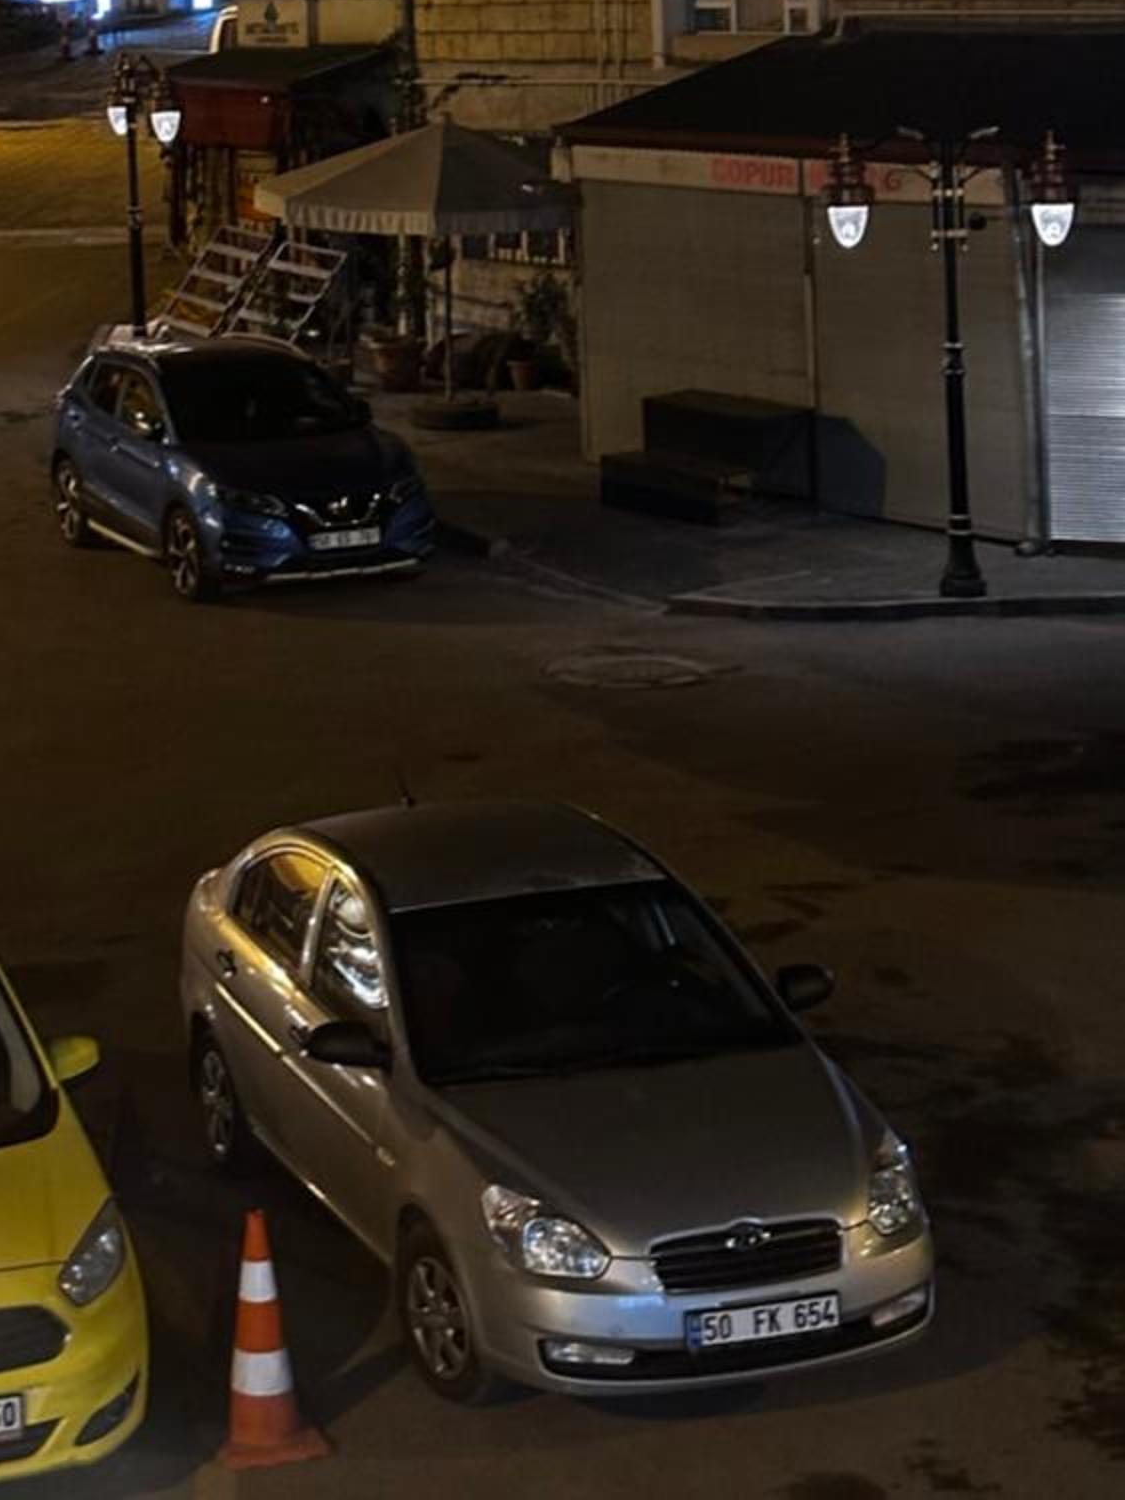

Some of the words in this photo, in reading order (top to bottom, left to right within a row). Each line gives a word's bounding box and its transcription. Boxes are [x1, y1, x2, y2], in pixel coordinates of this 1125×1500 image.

[703, 1314, 732, 1342] 50
[753, 1307, 781, 1334] FK
[793, 1299, 835, 1329] 654
